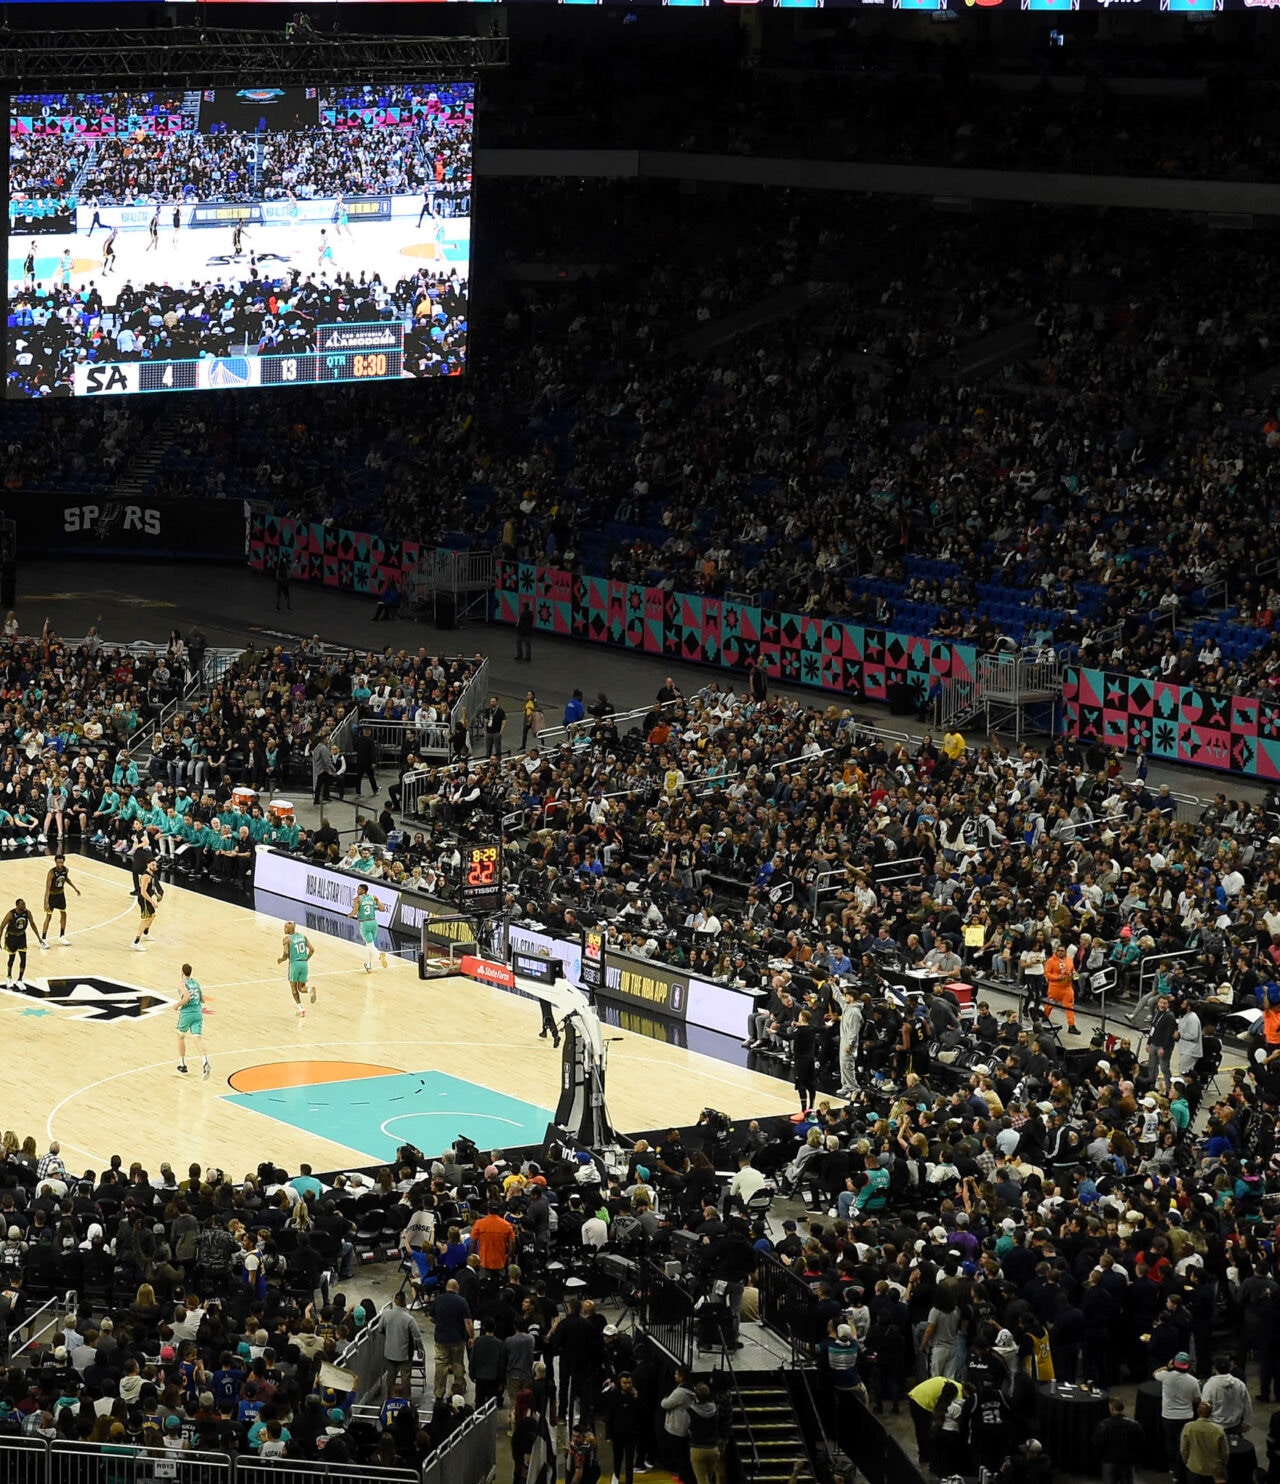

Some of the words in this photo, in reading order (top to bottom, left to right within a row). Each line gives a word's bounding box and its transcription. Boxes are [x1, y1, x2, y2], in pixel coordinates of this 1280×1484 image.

[281, 359, 297, 381] 13
[326, 356, 346, 368] QTR
[354, 354, 386, 377] 8:30
[86, 365, 128, 393] SA
[162, 364, 173, 387] 4
[472, 848, 497, 862] 8:29
[468, 862, 494, 885] 22
[306, 874, 317, 897] NBA
[317, 876, 340, 904] ALL-STAR
[475, 886, 499, 894] TISSOT
[364, 905, 370, 915] 3
[294, 942, 305, 954] 10
[606, 966, 621, 990] VOTE
[620, 970, 631, 993] ON
[630, 973, 643, 997] THE
[641, 976, 655, 1001] NBA
[653, 980, 668, 1004] APP
